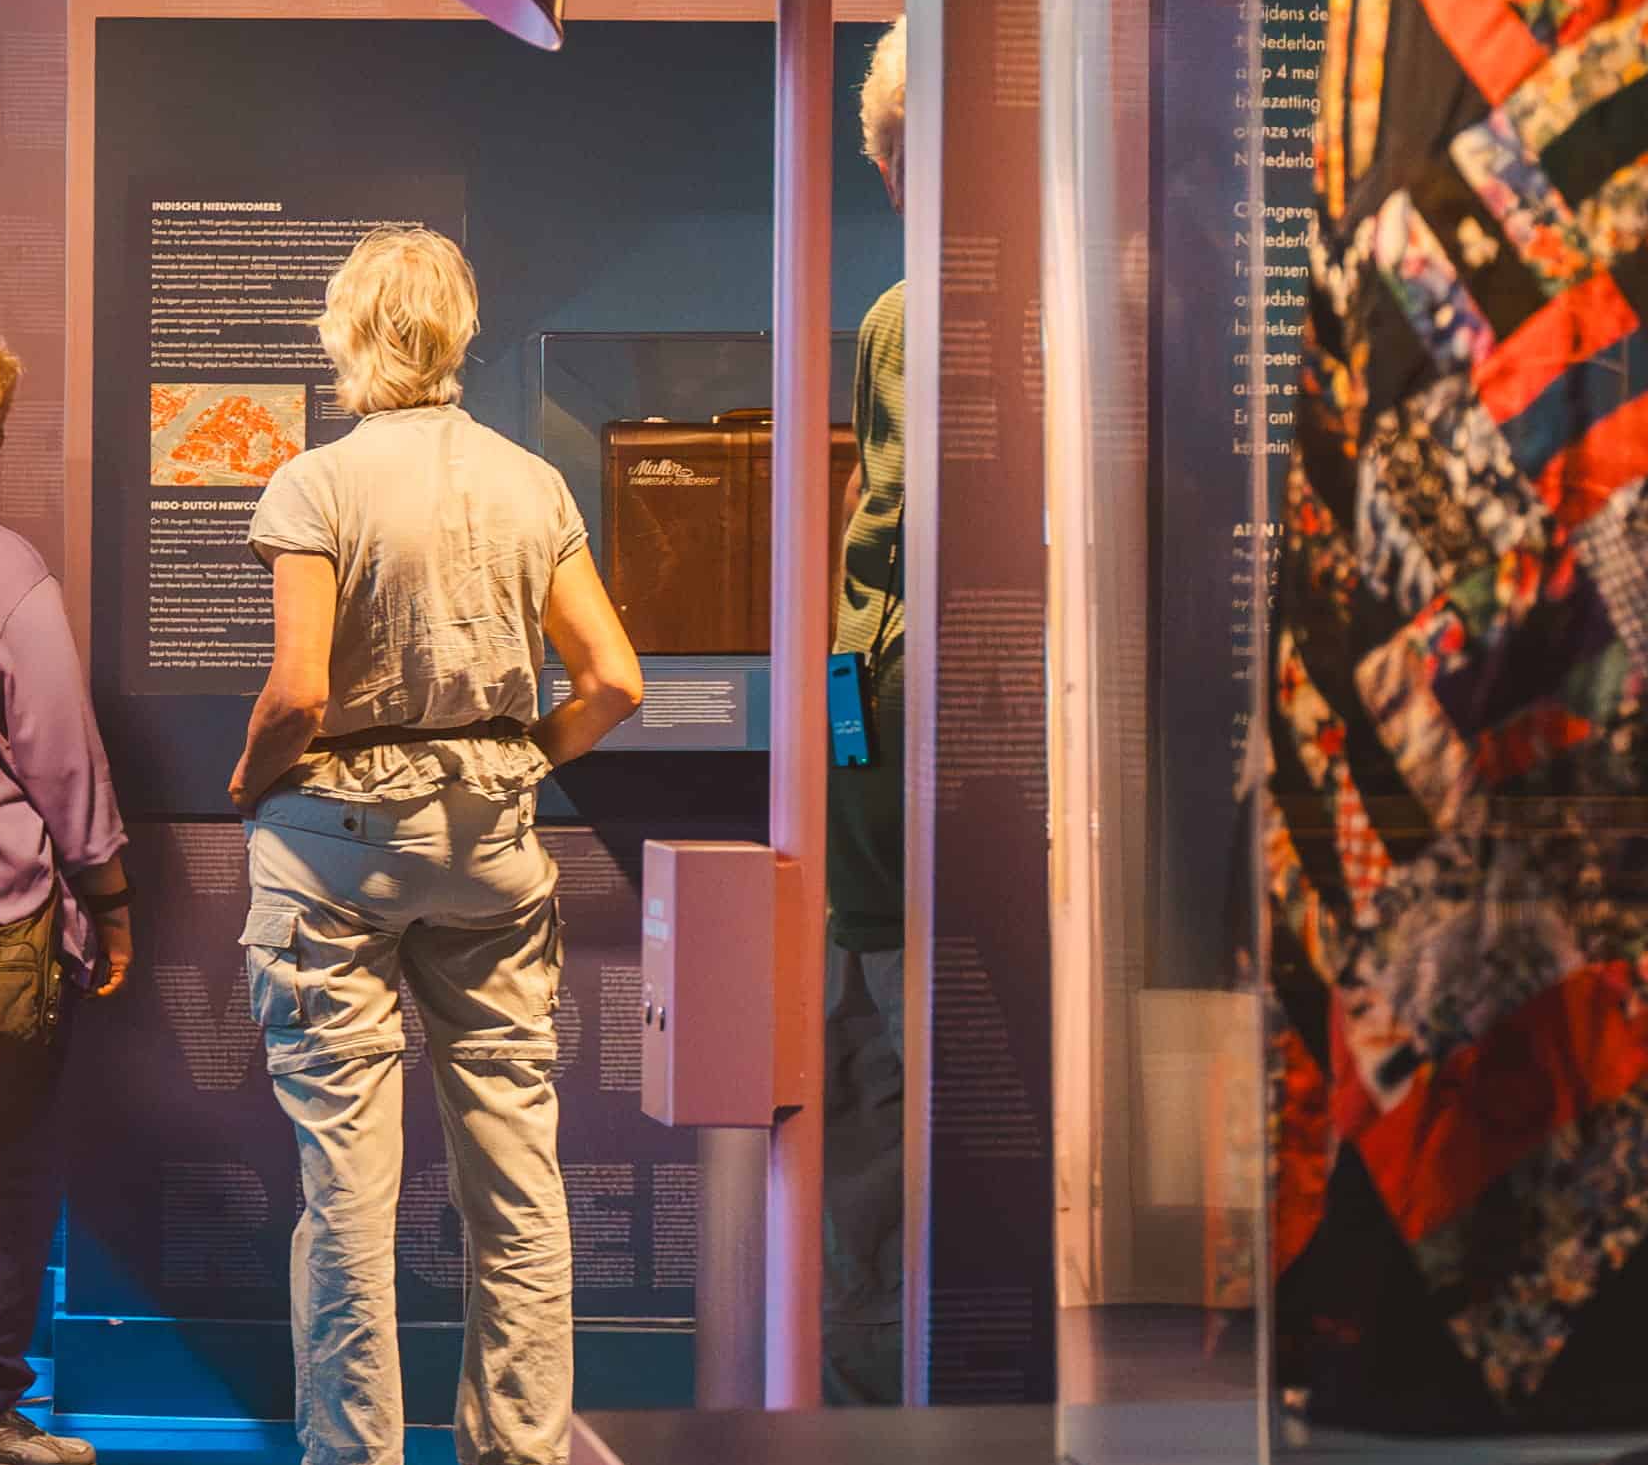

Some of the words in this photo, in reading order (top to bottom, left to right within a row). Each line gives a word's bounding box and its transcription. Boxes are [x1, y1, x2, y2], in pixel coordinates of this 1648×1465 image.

[152, 202, 200, 211] INDISCHE
[203, 202, 282, 211] NIEUWKOMERS
[151, 501, 217, 510] INDO-DUTCH
